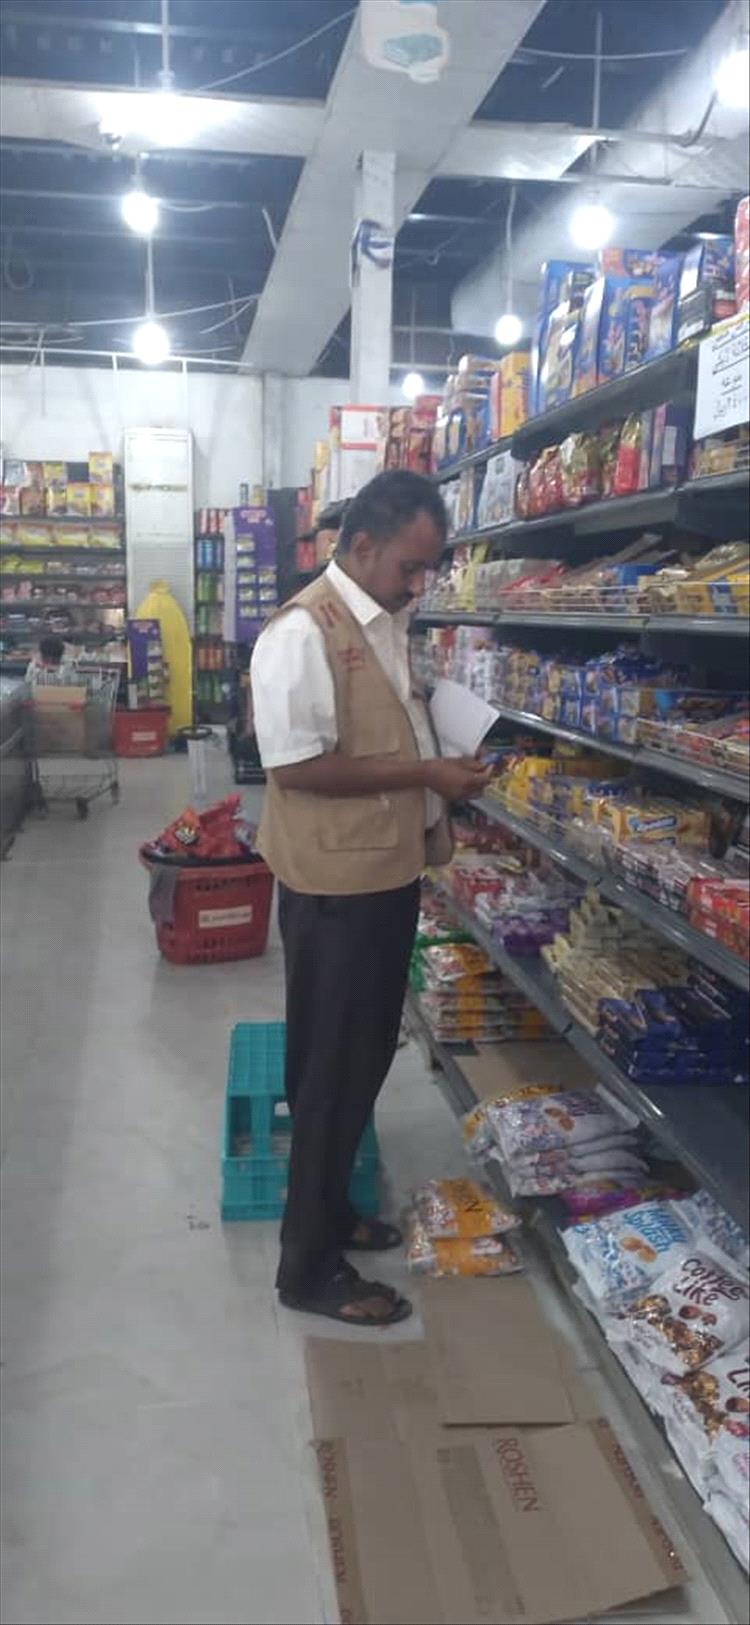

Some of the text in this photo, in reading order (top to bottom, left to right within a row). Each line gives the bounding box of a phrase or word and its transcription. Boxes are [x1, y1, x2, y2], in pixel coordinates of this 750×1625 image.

[673, 1275, 718, 1306] Like
[682, 1258, 745, 1301] Coffee
[497, 1437, 540, 1513] ROSHEN
